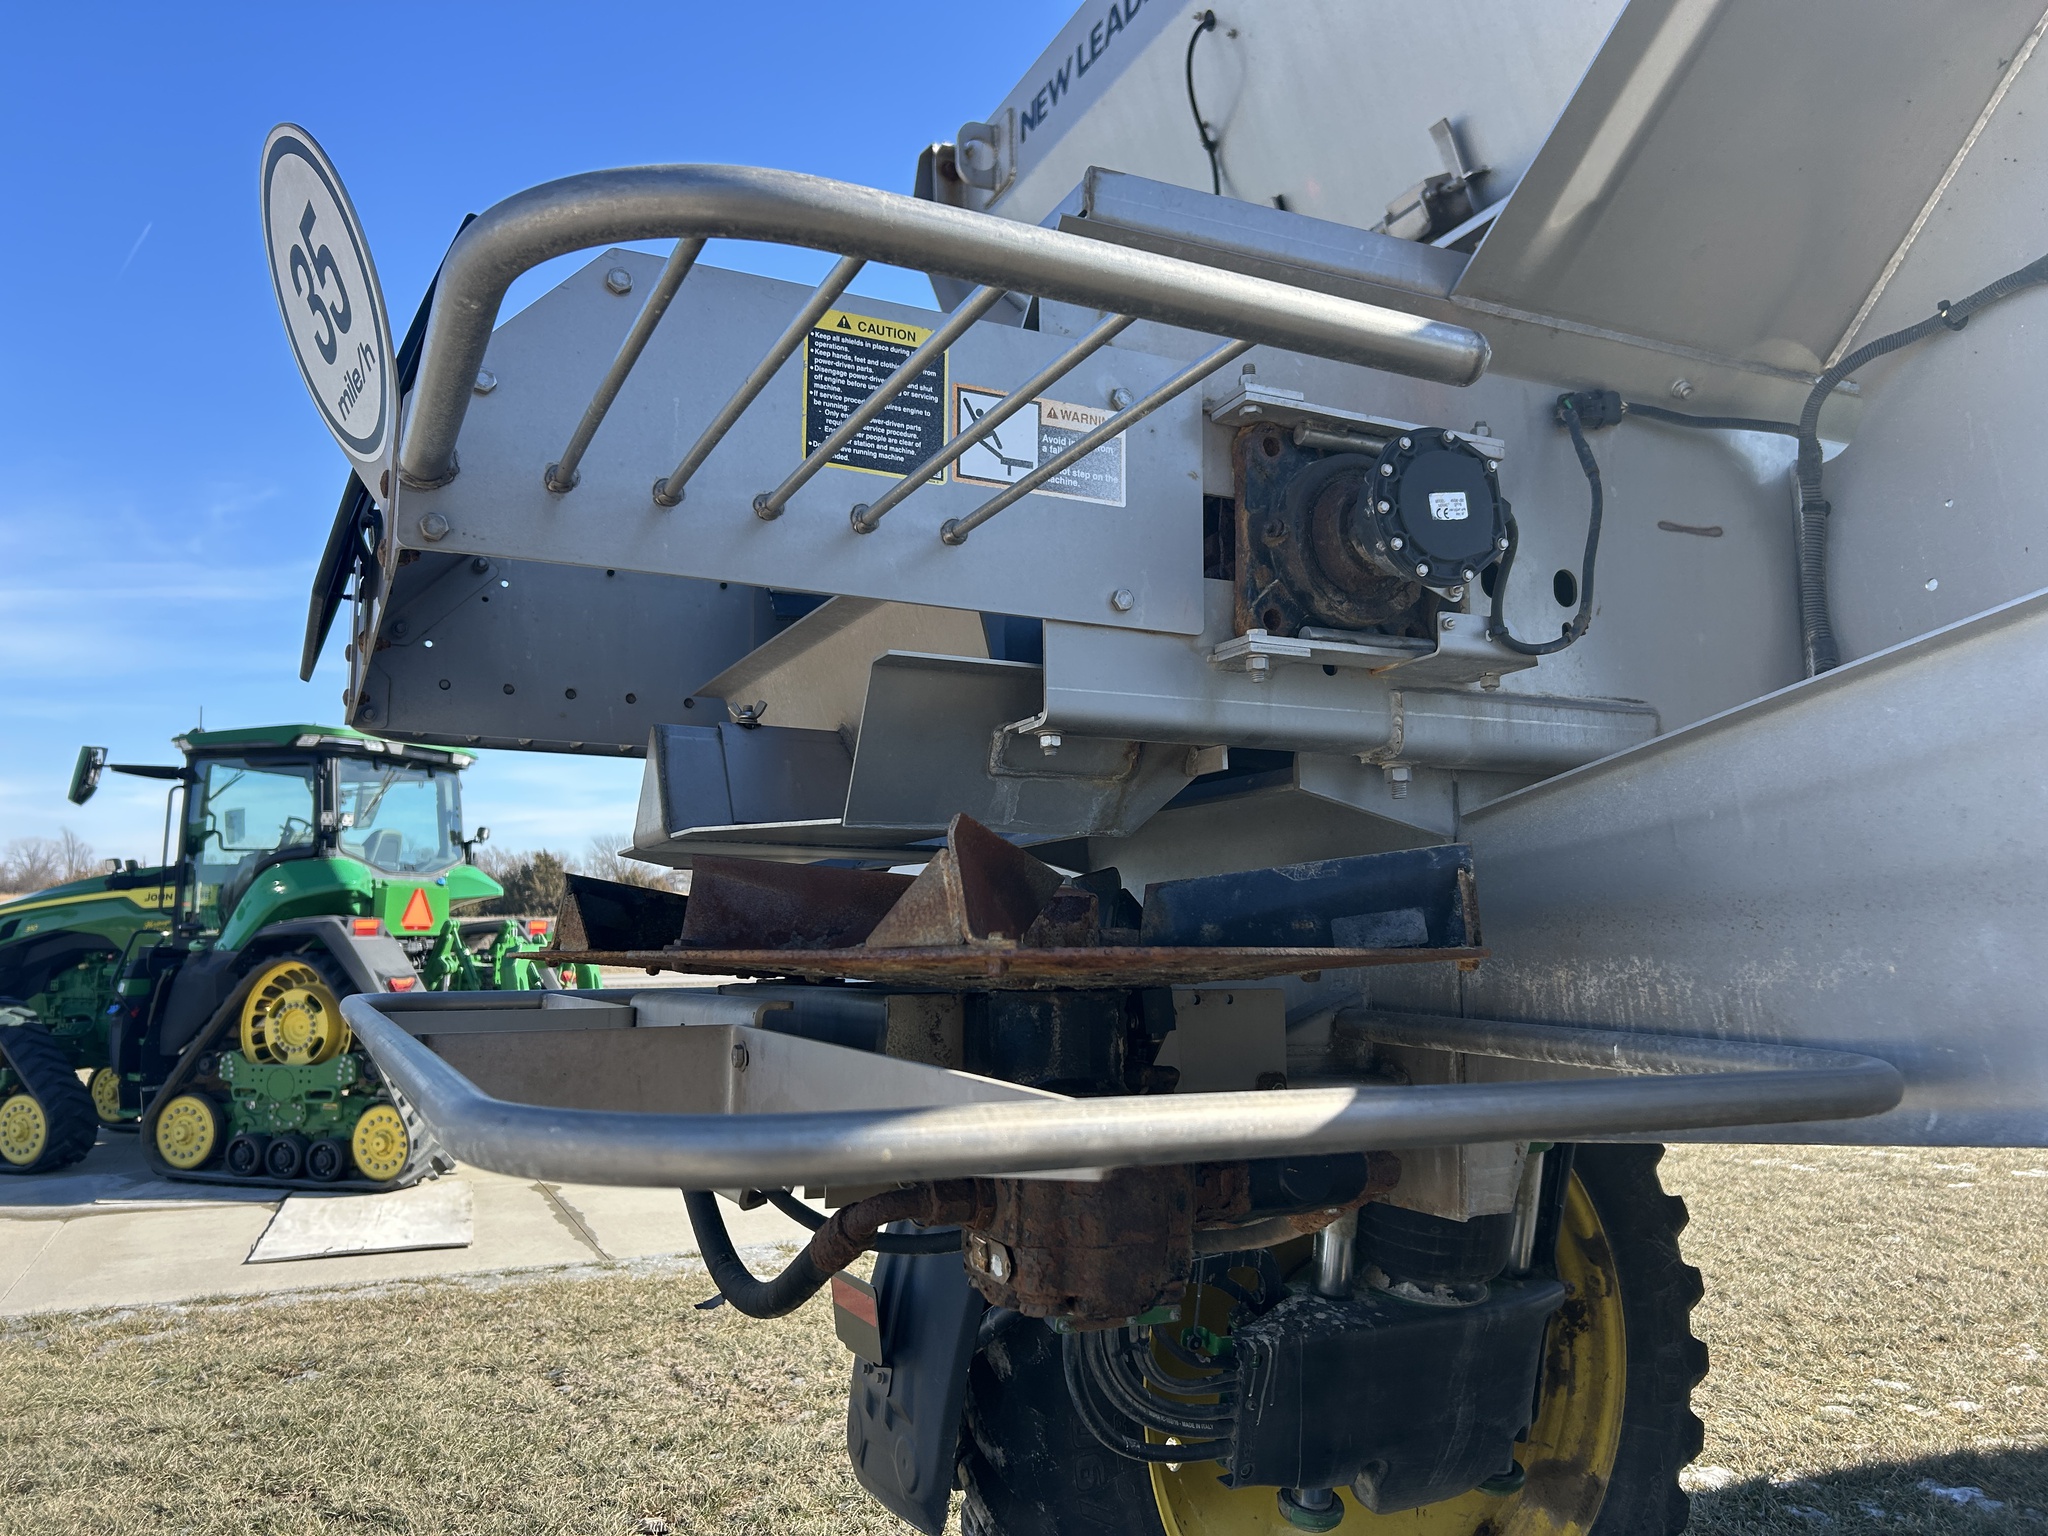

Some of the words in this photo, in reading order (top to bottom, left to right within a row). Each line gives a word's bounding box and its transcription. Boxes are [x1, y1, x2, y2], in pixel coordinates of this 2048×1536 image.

[1021, 54, 1073, 145] NEW
[1077, 0, 1148, 78] LEAD
[289, 199, 352, 366] 35
[857, 321, 916, 343] CAUTION
[814, 341, 850, 352] operations.
[815, 331, 831, 341] Keep
[841, 337, 864, 347] shields
[872, 343, 889, 352] place
[890, 346, 910, 357] during
[815, 348, 831, 358] Keep
[832, 351, 854, 362] hands,
[854, 355, 866, 364] feet
[814, 358, 855, 370] power-driven
[856, 366, 874, 374] parts.
[337, 342, 376, 422] mile/h
[814, 365, 848, 378] Disengage
[848, 373, 886, 384] power-drive
[813, 383, 843, 393] machine.
[824, 376, 846, 385] engine
[846, 379, 867, 389] before
[911, 392, 939, 403] servicing
[813, 398, 822, 406] be
[822, 401, 850, 411] running:
[819, 392, 843, 401] service
[902, 407, 923, 415] engine
[824, 408, 840, 418] Only
[865, 433, 887, 442] people
[898, 439, 914, 447] clear
[885, 429, 919, 440] procedure.
[1042, 434, 1067, 446] Avoid
[852, 448, 877, 459] running
[878, 452, 905, 462] machine
[853, 440, 875, 449] station
[875, 443, 888, 451] and
[888, 446, 917, 456] machine.
[1072, 469, 1091, 480] step
[1092, 473, 1103, 481] on
[1104, 474, 1119, 484] the
[1436, 507, 1449, 519] CE
[144, 892, 173, 903] JON
